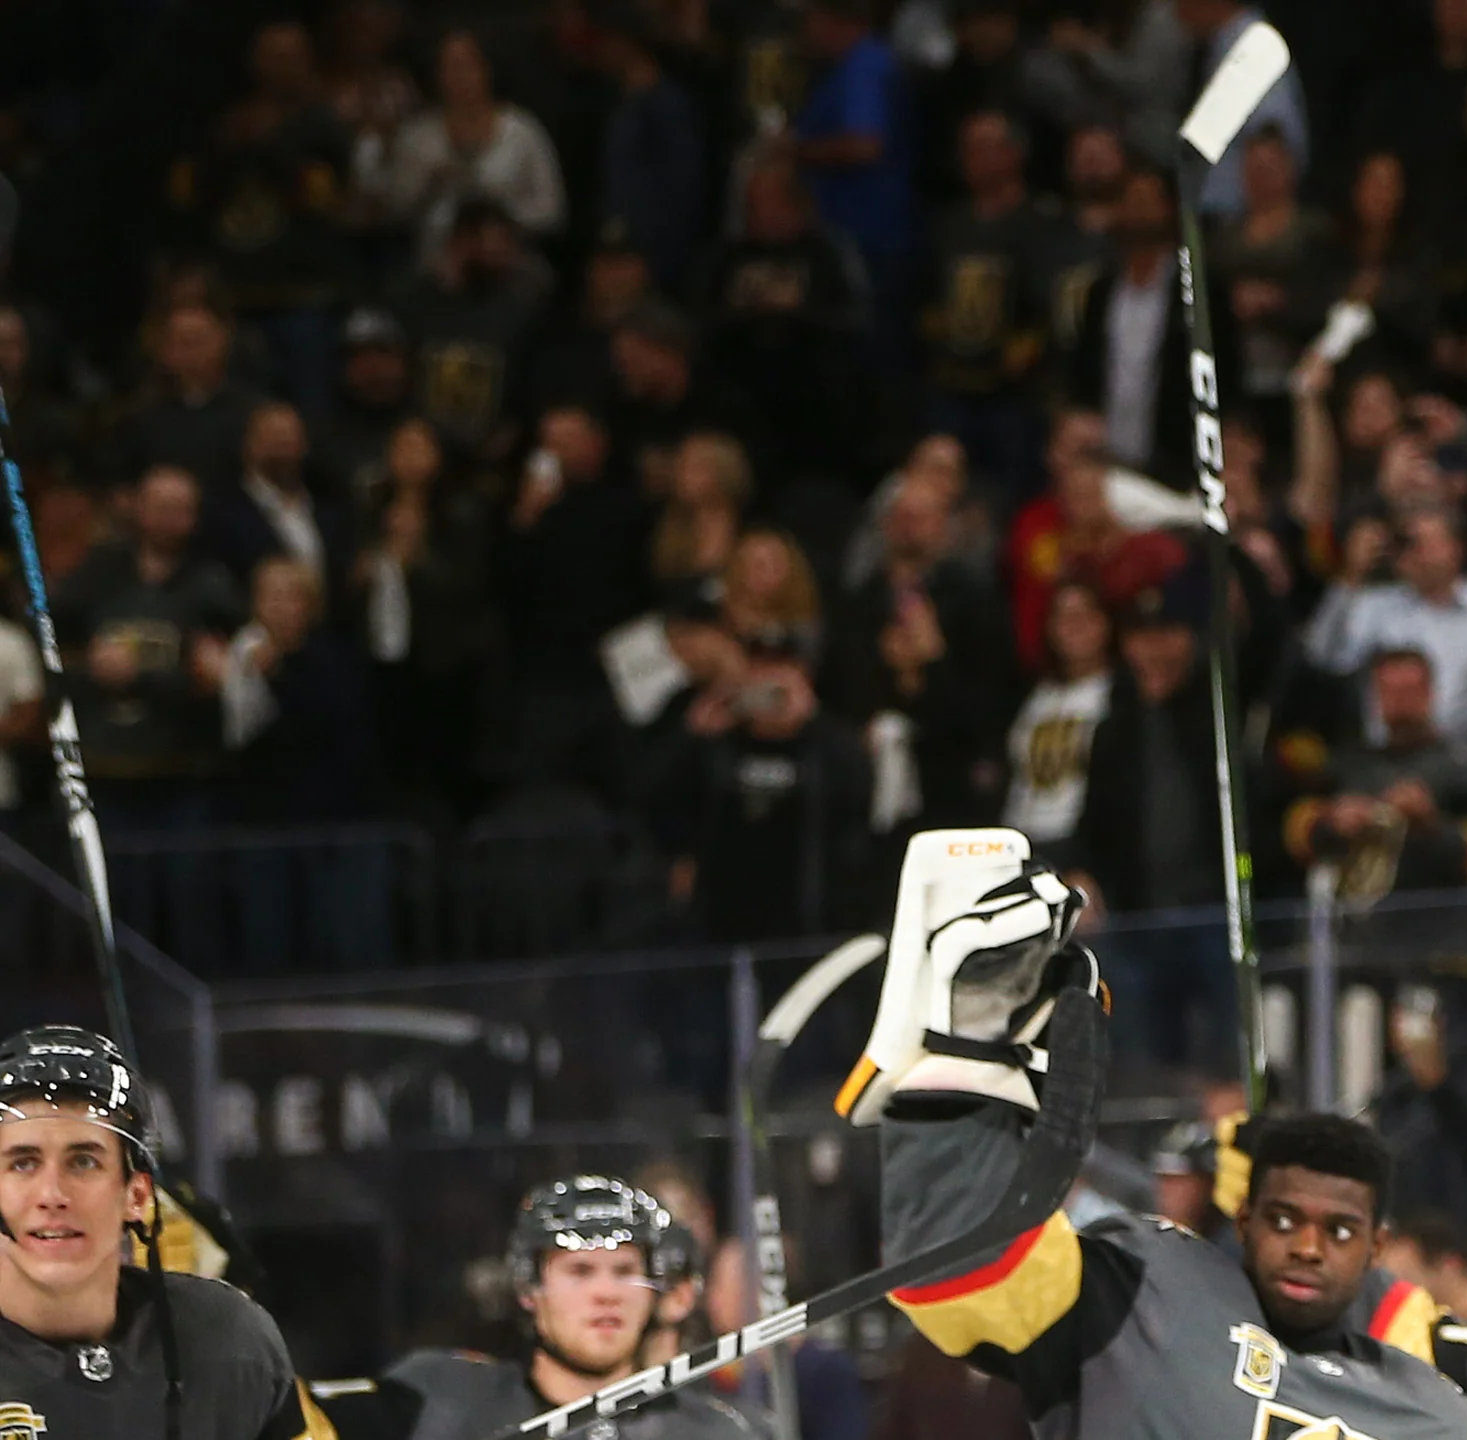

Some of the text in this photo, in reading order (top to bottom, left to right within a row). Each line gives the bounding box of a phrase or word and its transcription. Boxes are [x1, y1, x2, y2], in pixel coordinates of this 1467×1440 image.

[1190, 349, 1229, 535] CCM
[948, 842, 1004, 857] CCM
[520, 1303, 807, 1438] TRUE
